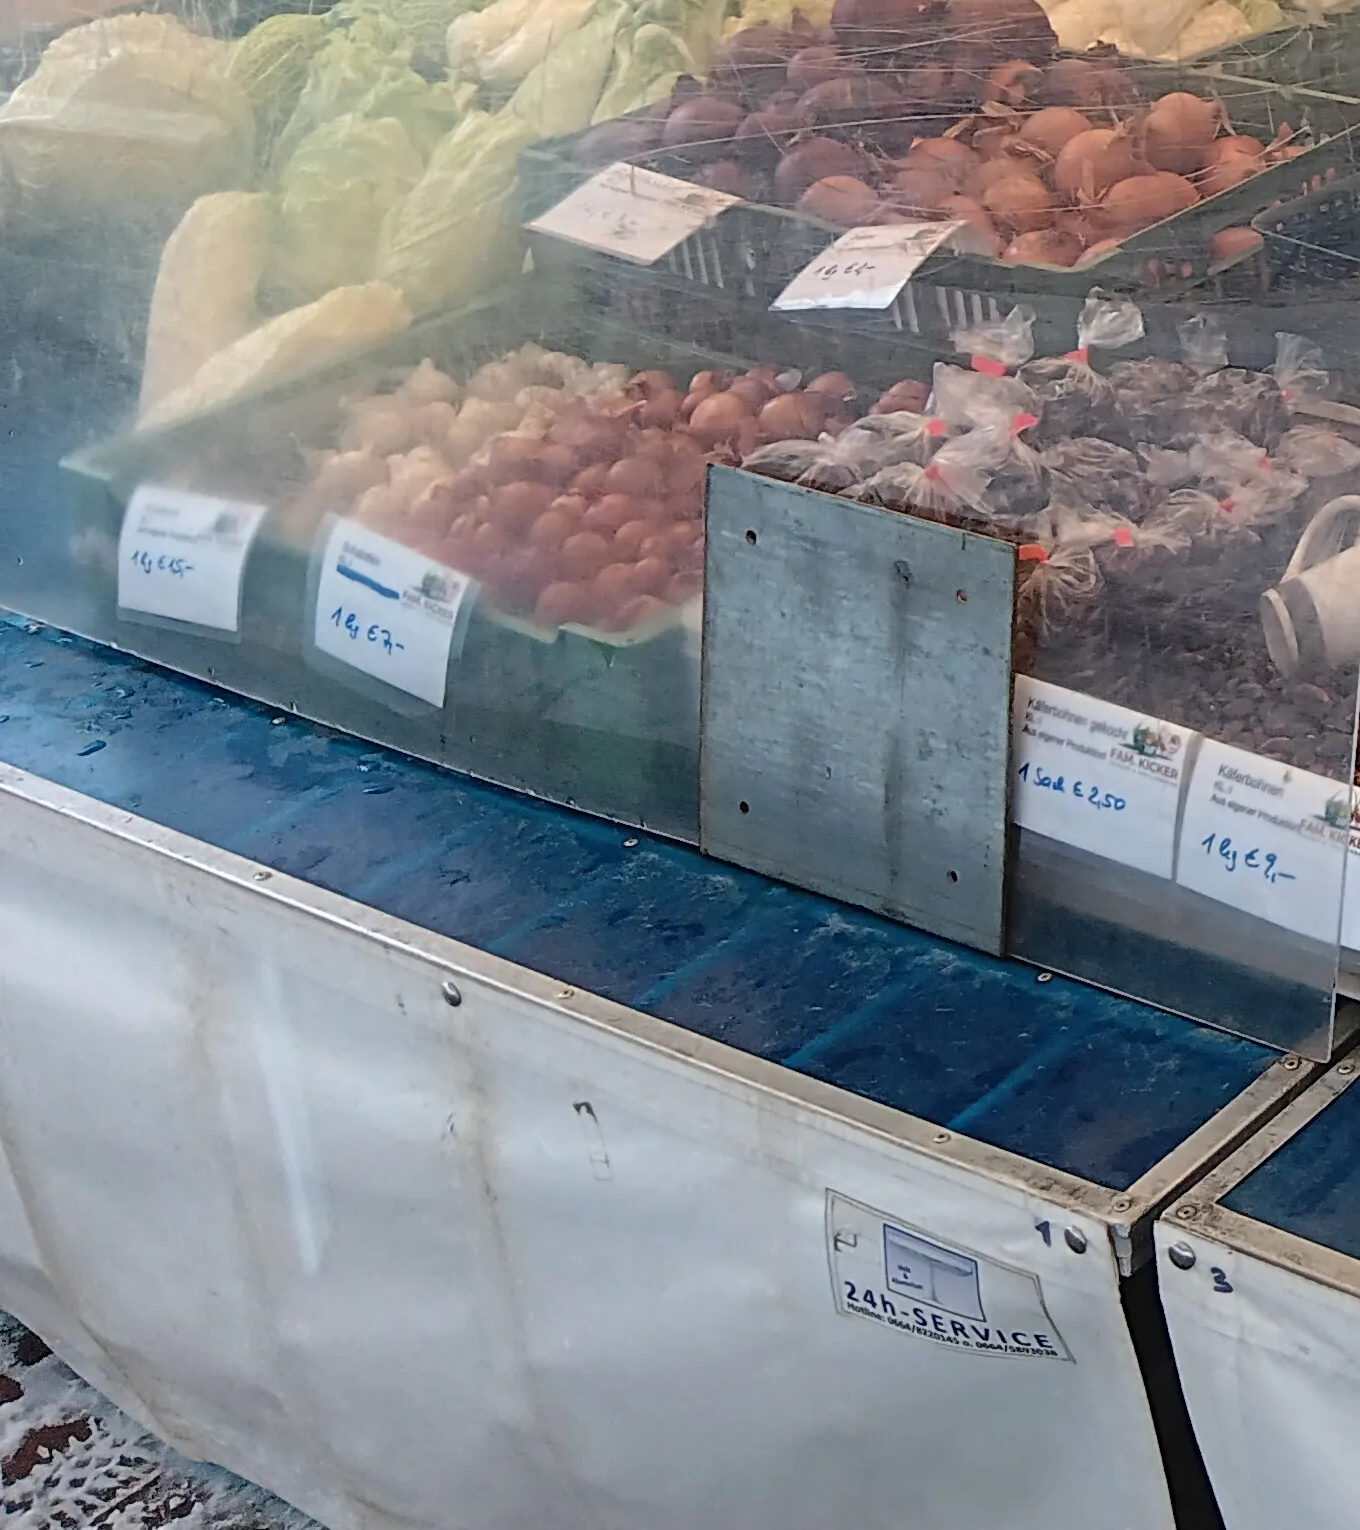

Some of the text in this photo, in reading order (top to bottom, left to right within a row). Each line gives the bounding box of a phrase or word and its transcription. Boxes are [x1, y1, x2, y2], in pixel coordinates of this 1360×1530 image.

[1138, 757, 1179, 779] KICKER
[1210, 1266, 1234, 1294] 3
[847, 1302, 885, 1323] Hotline:
